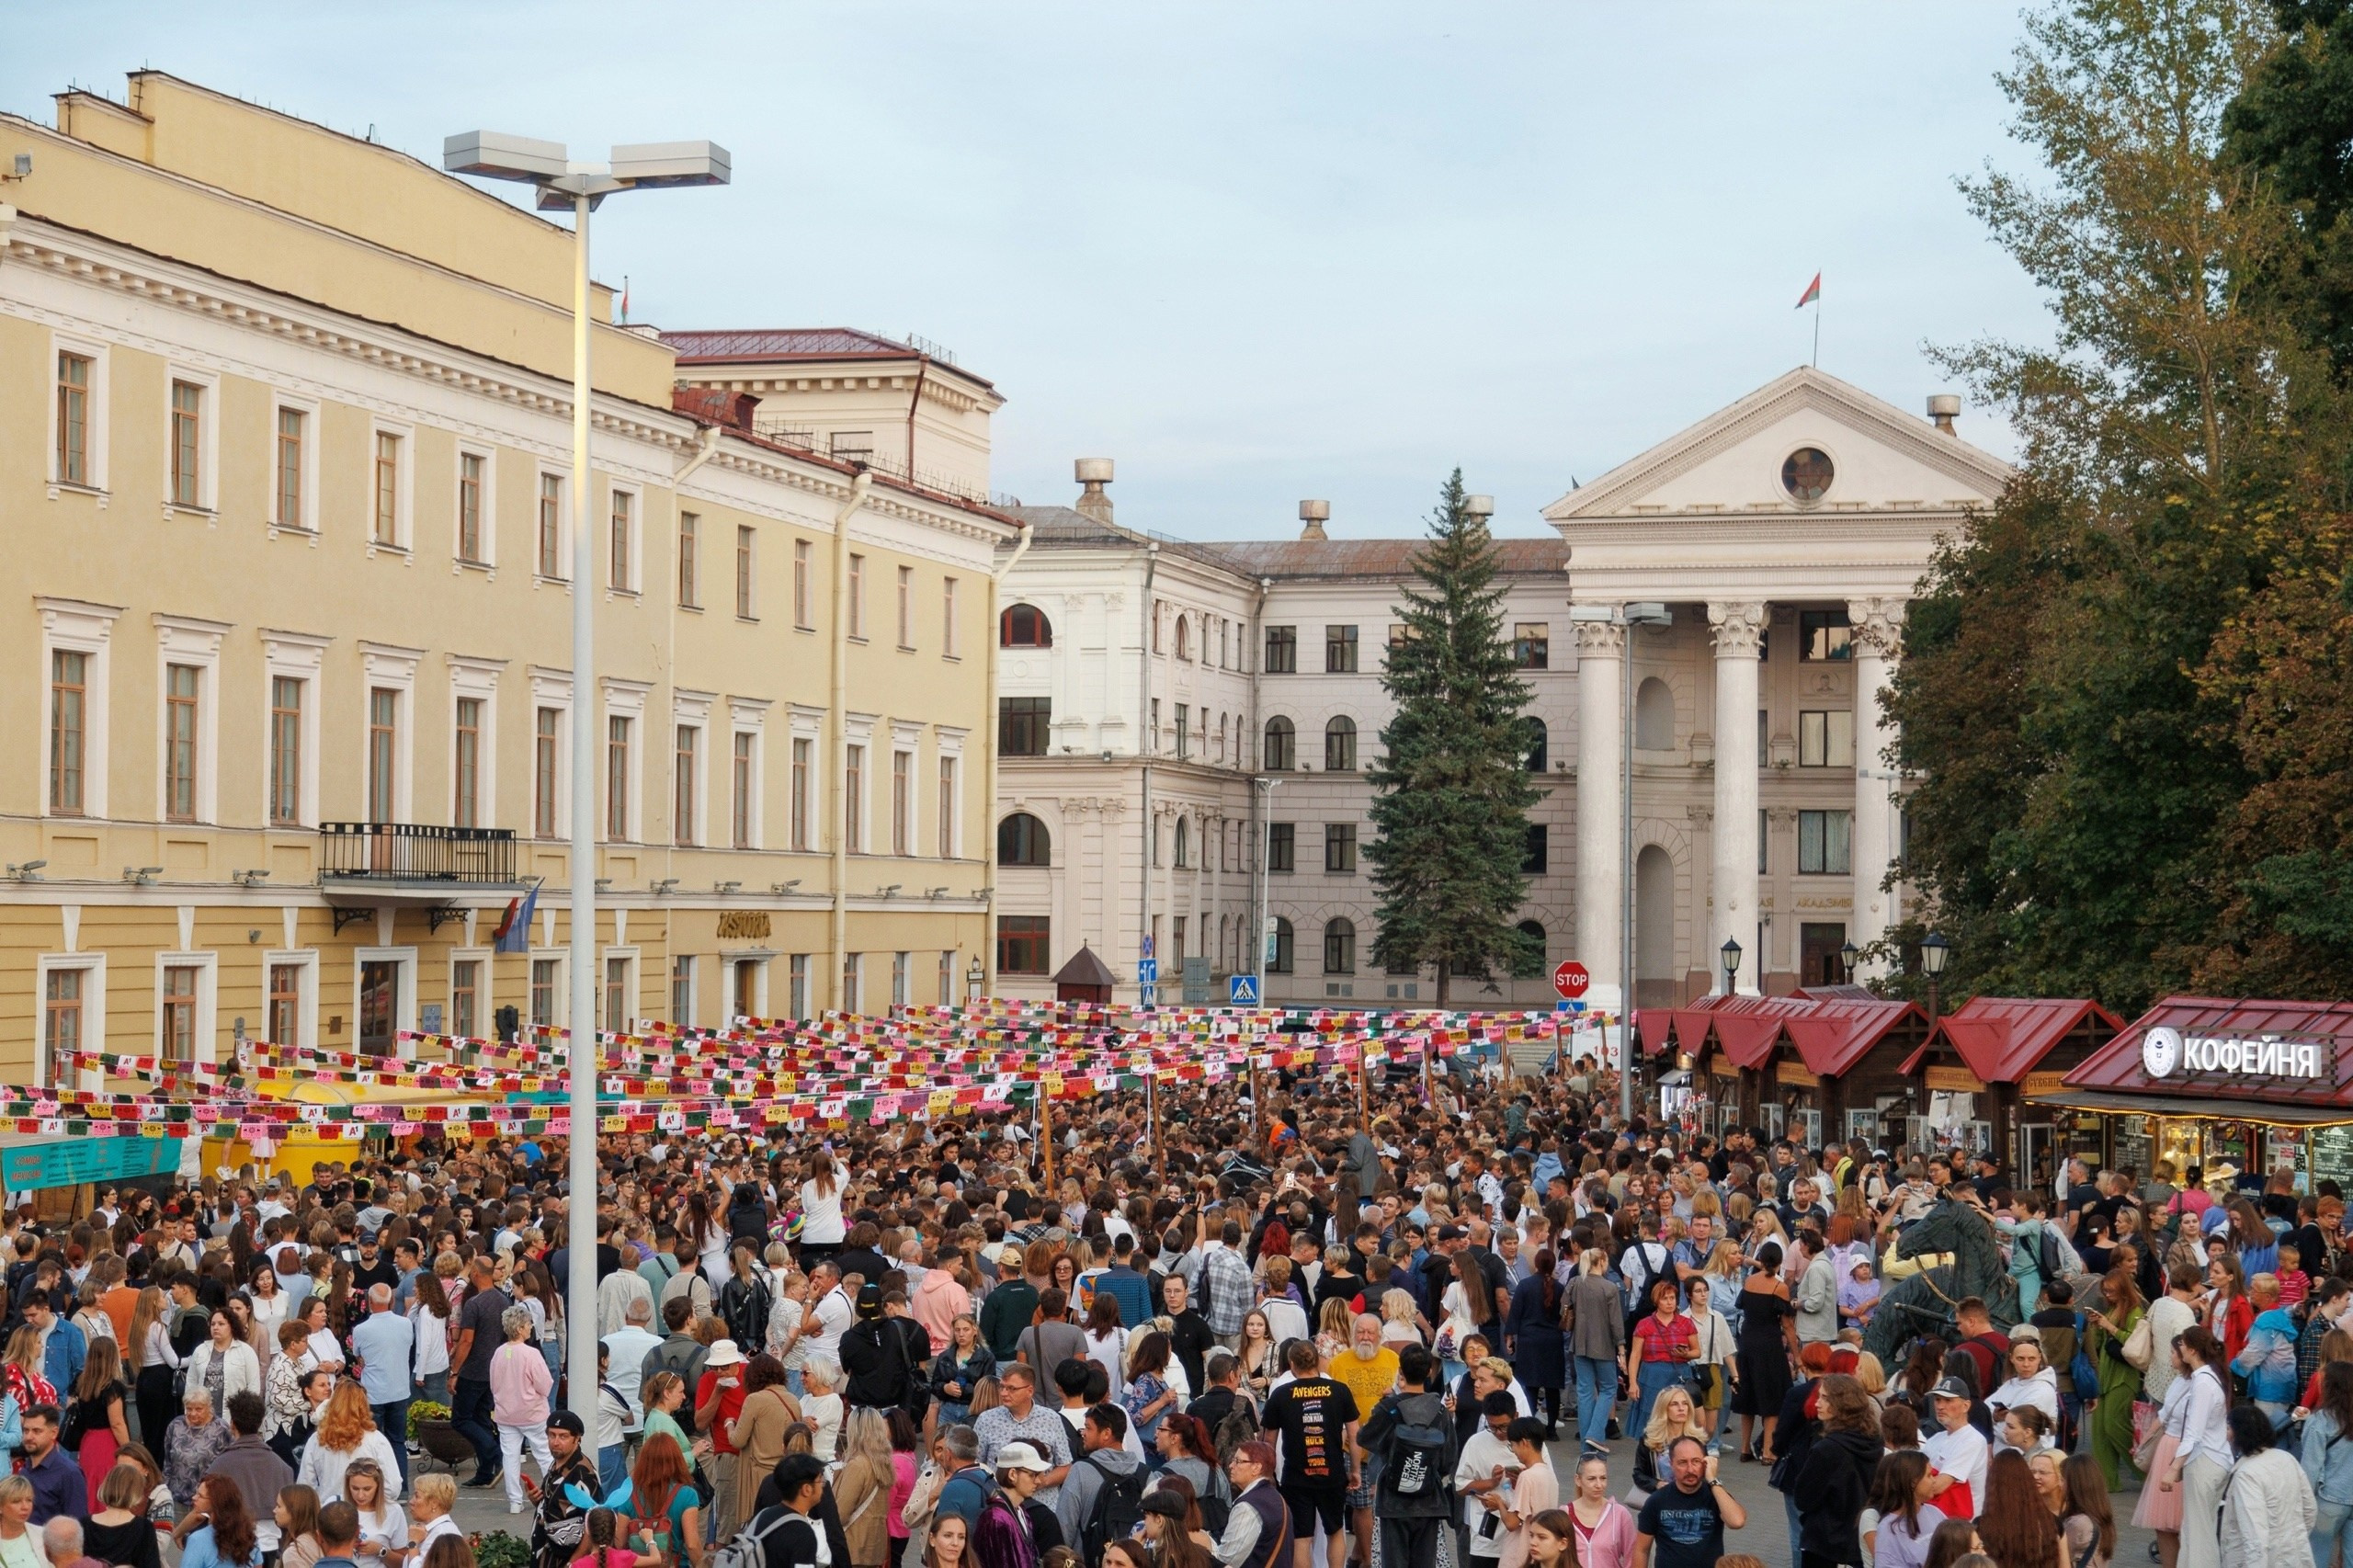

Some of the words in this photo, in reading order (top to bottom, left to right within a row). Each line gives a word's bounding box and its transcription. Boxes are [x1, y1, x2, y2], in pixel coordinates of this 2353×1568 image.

[1557, 974, 1587, 986] STOP
[2184, 1035, 2317, 1078] КОФЕЙНЯ
[1212, 1063, 1219, 1071] A1
[1102, 1078, 1111, 1087] A1
[991, 1088, 1000, 1097] A1
[150, 1106, 158, 1115] A1
[308, 1108, 317, 1117] A1
[453, 1108, 460, 1117] A1
[826, 1103, 836, 1113] A1
[918, 1108, 925, 1117] A1
[665, 1114, 674, 1125] A1
[793, 1120, 800, 1128] A1
[48, 1122, 57, 1131] A1
[201, 1123, 209, 1133] A1
[349, 1126, 358, 1136] A1
[507, 1121, 516, 1131] A1
[1292, 1386, 1331, 1398] AVENGERS
[1305, 1437, 1324, 1446] HULK
[1402, 1457, 1413, 1479] FACE
[1409, 1451, 1423, 1483] NORTH
[1416, 1465, 1427, 1483] THE
